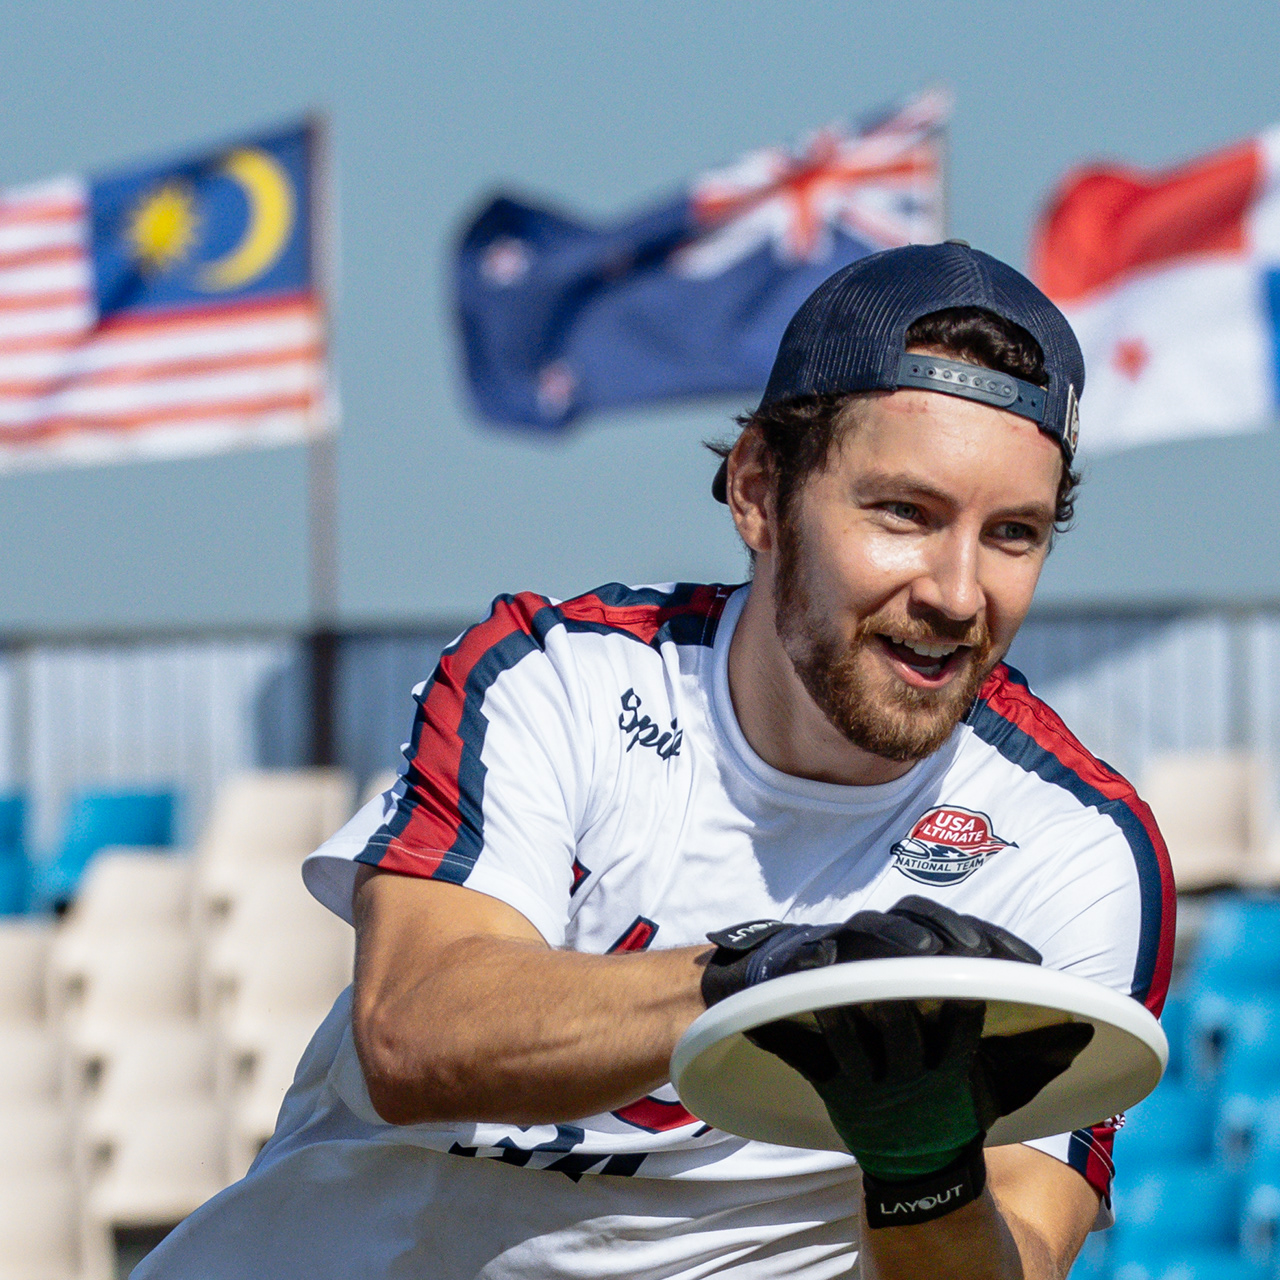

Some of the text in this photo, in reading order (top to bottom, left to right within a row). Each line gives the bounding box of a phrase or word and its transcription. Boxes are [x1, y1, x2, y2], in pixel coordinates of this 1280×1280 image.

[935, 811, 976, 832] USA
[895, 857, 985, 872] NATIONAL TEAM
[880, 1184, 963, 1215] LAYOUT
